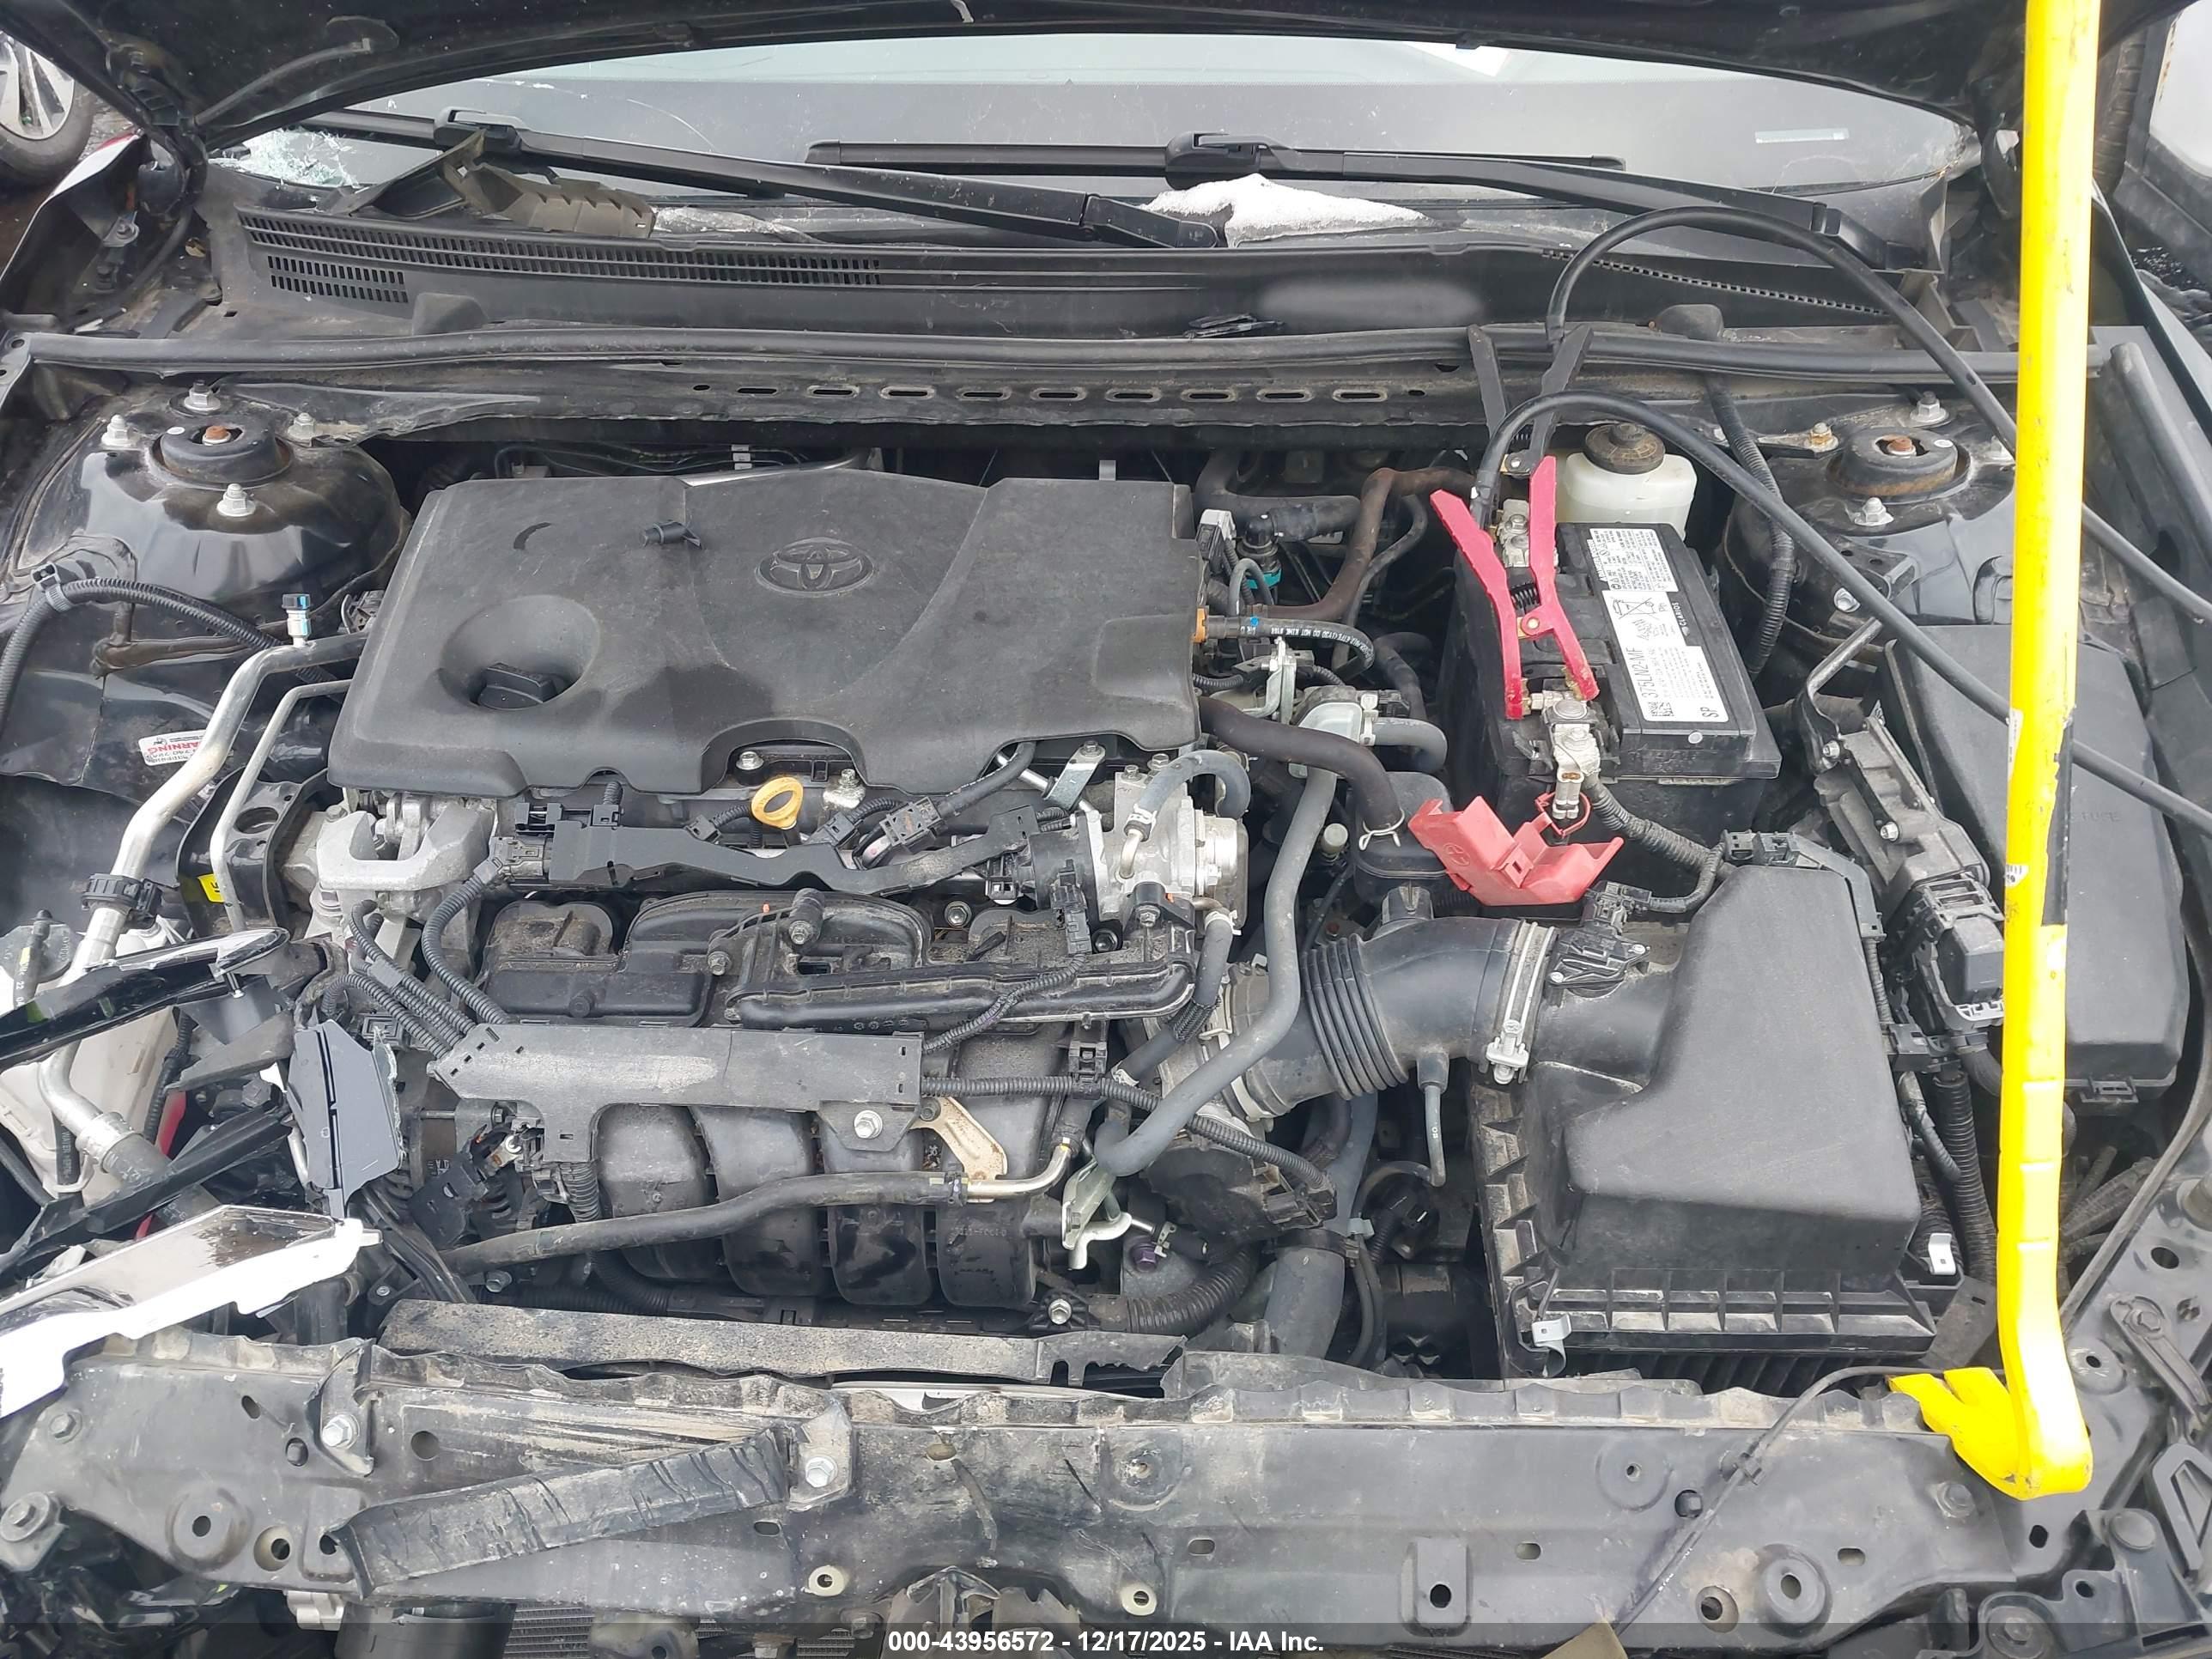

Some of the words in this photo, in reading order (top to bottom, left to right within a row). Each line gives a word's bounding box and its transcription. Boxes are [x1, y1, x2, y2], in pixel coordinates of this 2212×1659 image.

[1671, 602, 1687, 626] CLARIOS
[1626, 647, 1658, 698] 375LN2-MF
[1699, 707, 1719, 718] SP
[147, 741, 202, 755] ARNING
